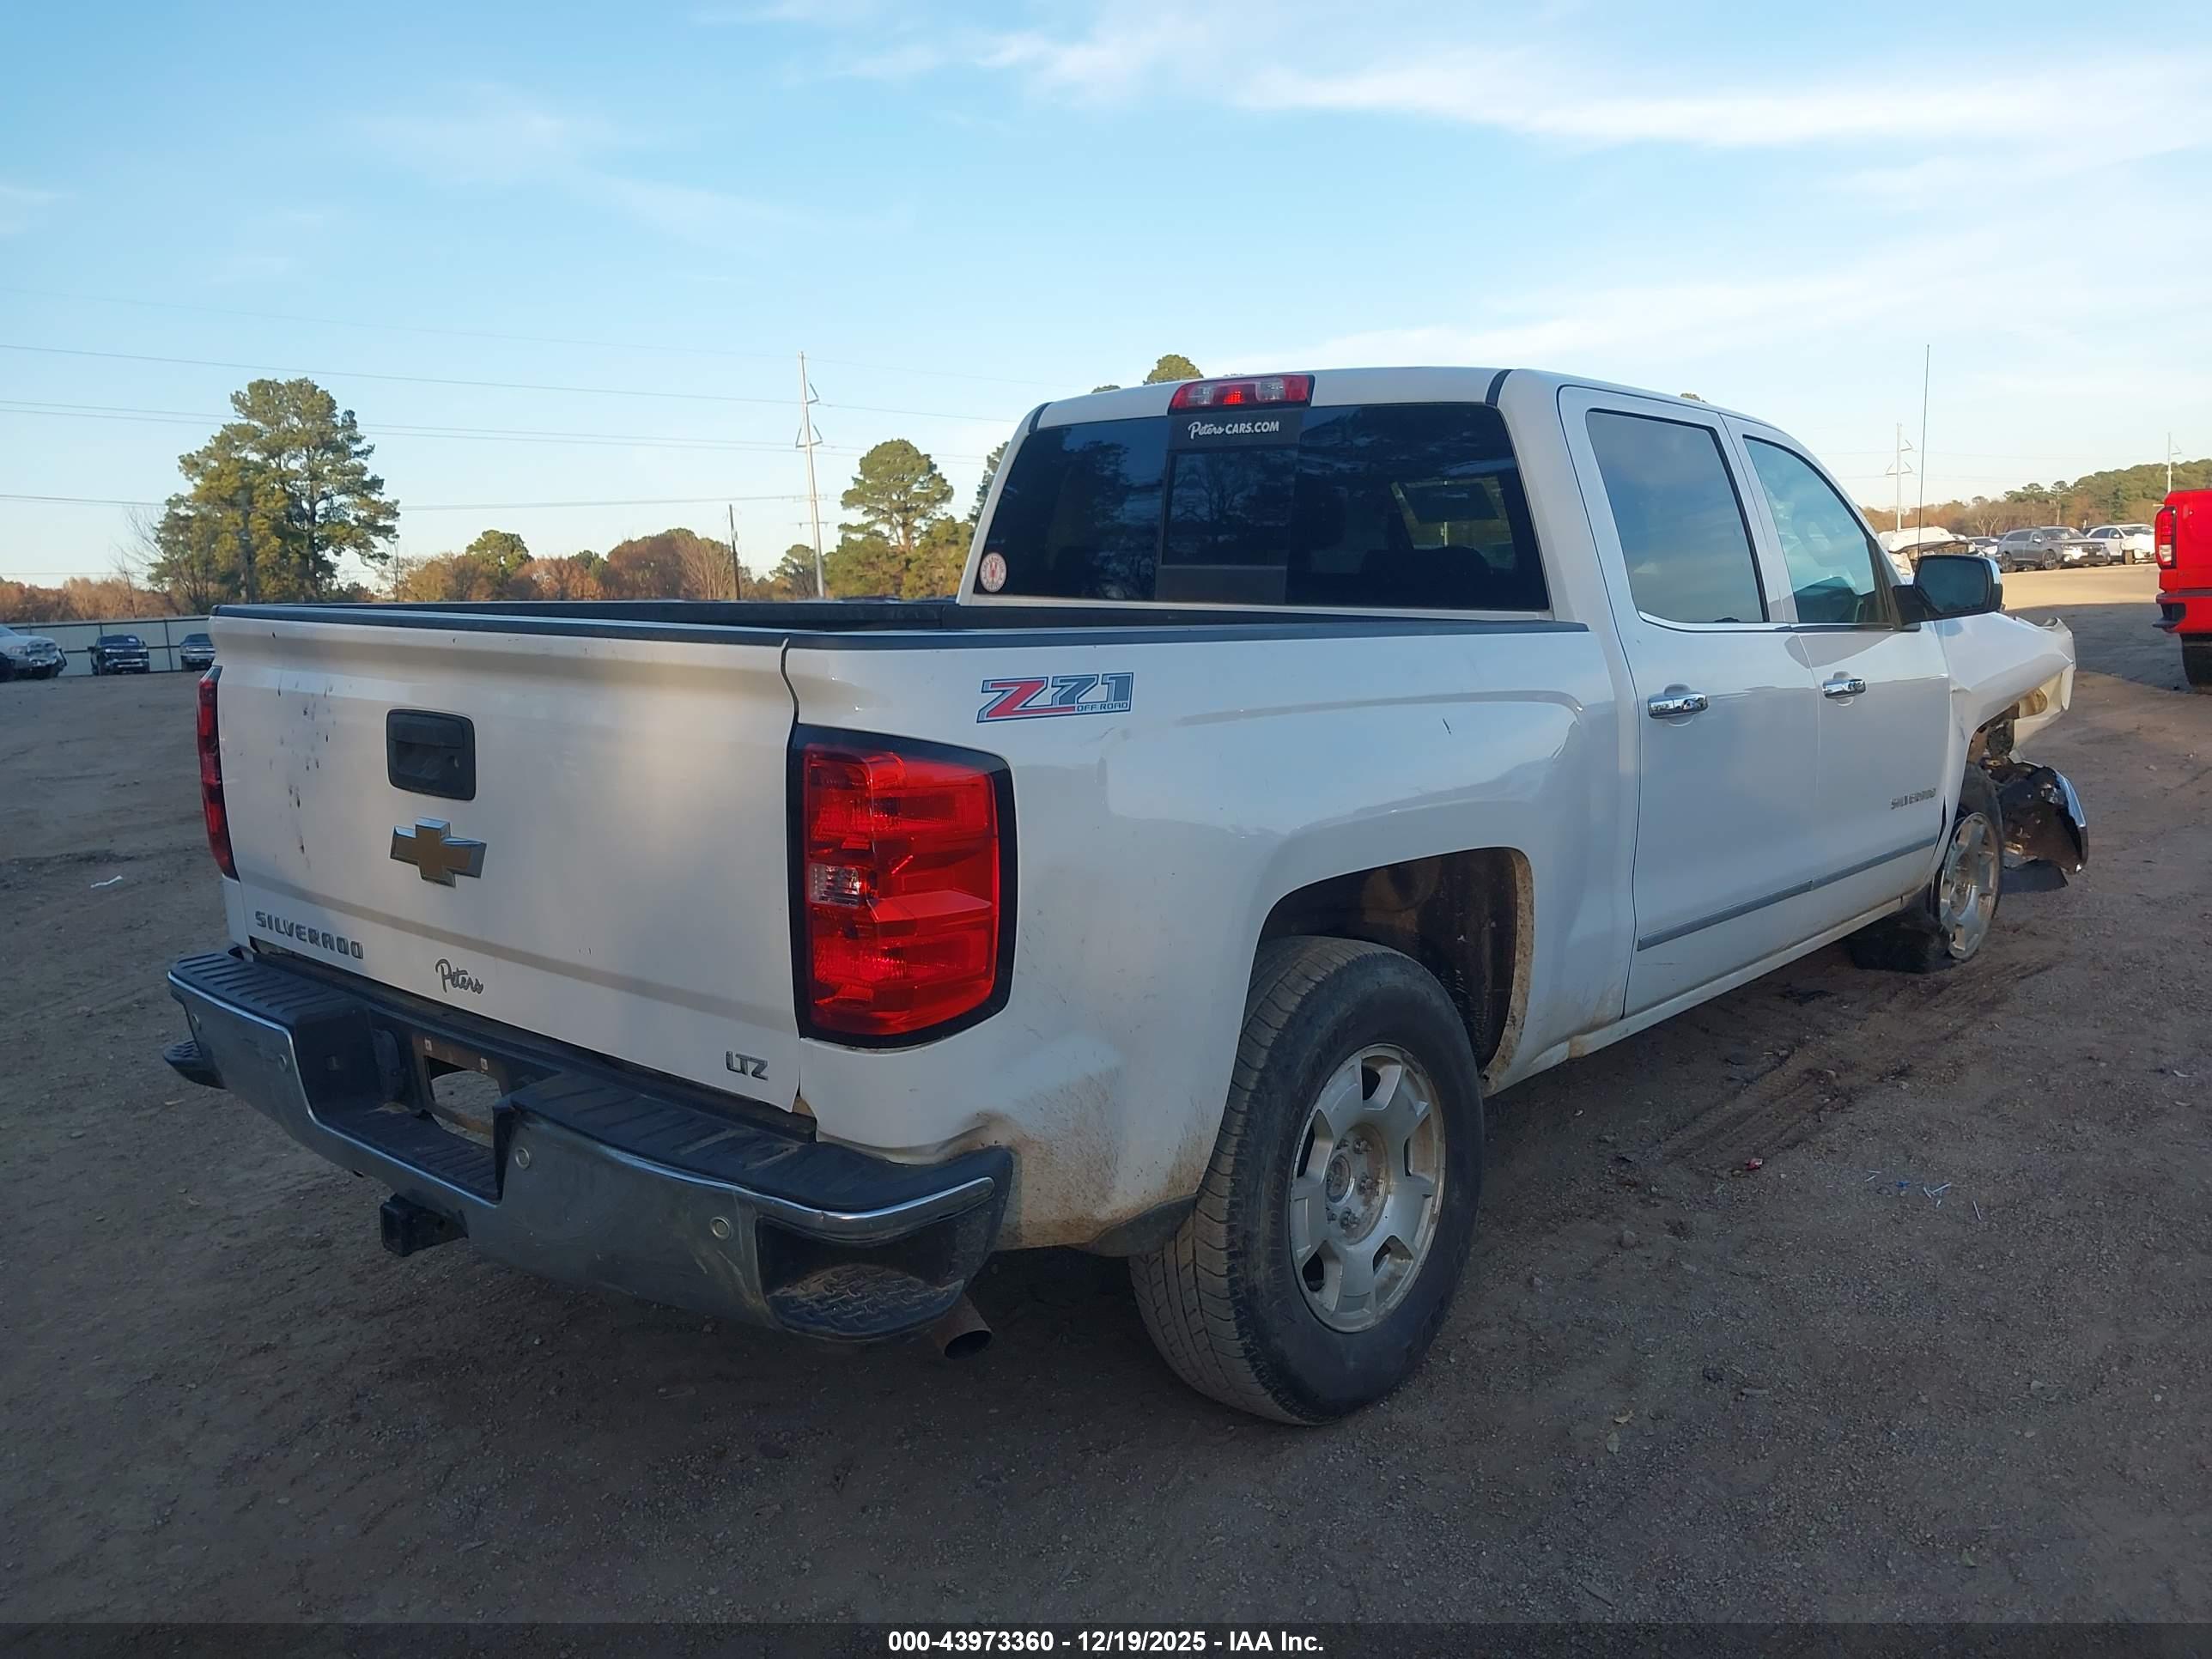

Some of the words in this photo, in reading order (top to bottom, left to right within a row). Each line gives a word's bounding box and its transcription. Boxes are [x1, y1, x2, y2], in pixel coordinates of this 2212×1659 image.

[1188, 421, 1224, 440] Peters
[1224, 421, 1279, 434] CARS.COM
[976, 672, 1134, 724] Z71
[1077, 704, 1097, 713] OFF
[1099, 702, 1128, 711] ROAD
[254, 910, 365, 960] SILVERADO
[434, 957, 484, 994] Peters
[726, 1050, 769, 1081] LTZ
